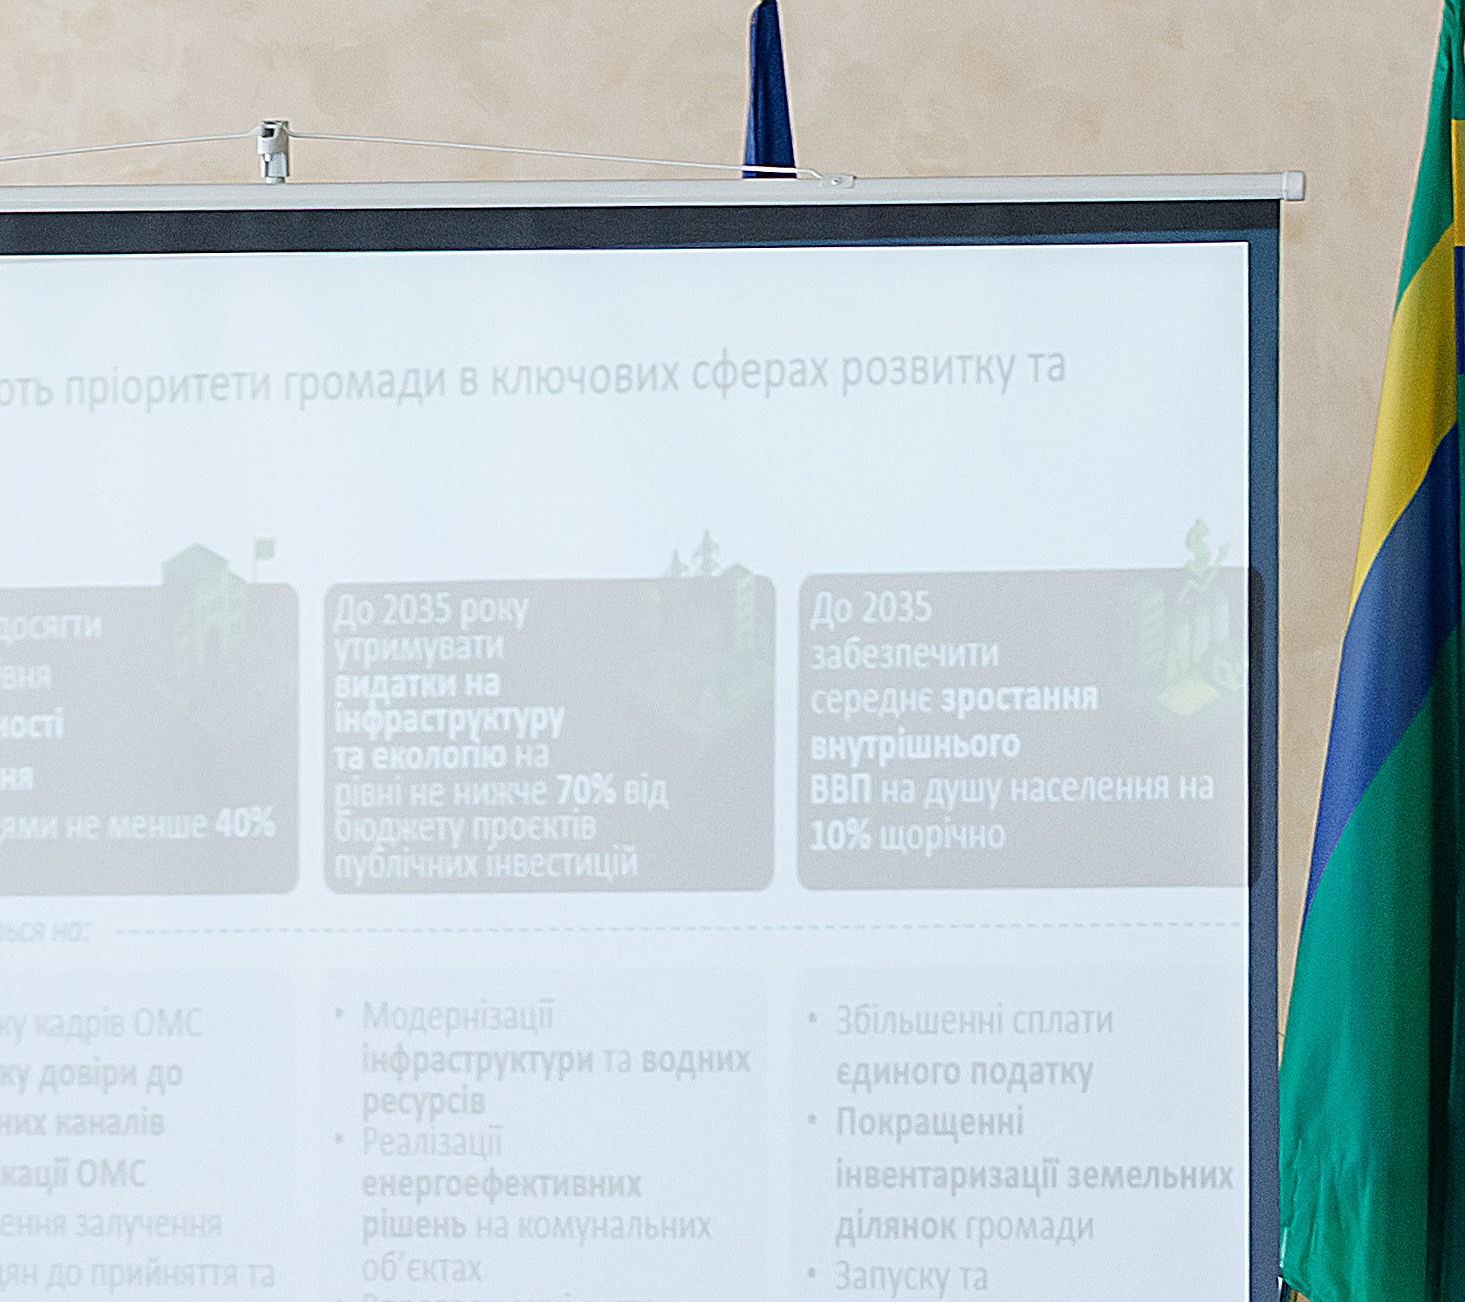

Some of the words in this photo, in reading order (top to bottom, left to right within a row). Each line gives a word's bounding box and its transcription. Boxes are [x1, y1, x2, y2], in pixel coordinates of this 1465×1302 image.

[66, 366, 270, 414] пріоритети
[285, 368, 445, 410] громади
[460, 367, 478, 395] в
[492, 361, 680, 395] ключових
[692, 346, 829, 399] сферах
[843, 353, 1016, 398] розвитку
[1029, 352, 1067, 382] та
[333, 594, 372, 632] До
[383, 593, 452, 624] 2035
[461, 598, 529, 630] року
[810, 592, 851, 630] До
[862, 591, 932, 623] 2035
[334, 635, 504, 670] утримувати
[812, 636, 999, 669] забезпечити
[335, 673, 456, 705] видатки
[465, 672, 501, 696] на
[812, 688, 933, 721] середнє
[941, 686, 1099, 719] зростання
[334, 702, 566, 740] інфраструктуру
[334, 747, 363, 770] та
[515, 744, 549, 768] на
[811, 727, 1020, 767] внутрішнього
[335, 774, 402, 812] рівні
[410, 781, 444, 806] не
[453, 779, 548, 805] нижче
[557, 773, 615, 804] 70%
[625, 772, 669, 809] від
[811, 774, 871, 804] ВВП
[881, 778, 915, 804] на
[923, 778, 1001, 810] душу
[1011, 774, 1169, 802] населення
[1180, 774, 1214, 800] на
[335, 809, 465, 849] бюджету
[811, 818, 871, 850] 10%
[880, 817, 1005, 857] щорічно
[334, 847, 478, 886] публічних
[486, 844, 638, 882] інвестицій
[35, 1006, 124, 1044] кадрів
[134, 1008, 203, 1038] ОМС
[362, 998, 555, 1037] Модернізації
[836, 1003, 1003, 1035] Збільшенні
[1012, 1010, 1114, 1035] сплати
[39, 1056, 137, 1094] довіри
[146, 1064, 183, 1094] до
[362, 1043, 593, 1081] інфраструктури
[603, 1049, 632, 1073] та
[642, 1049, 751, 1080] водних
[836, 1062, 960, 1093] єдиного
[971, 1061, 1094, 1093] податку
[55, 1106, 165, 1136] каналів
[362, 1085, 486, 1122] ресурсів
[362, 1124, 503, 1161] Реалізації
[836, 1105, 1024, 1144] Покращенні
[77, 1159, 146, 1187] ОМС
[362, 1167, 642, 1204] енергоефективних
[836, 1158, 1060, 1197] інвентаризації
[1067, 1164, 1234, 1190] земельних
[76, 1214, 222, 1245] залучення
[362, 1207, 467, 1246] рішень
[476, 1216, 508, 1239] на
[518, 1216, 712, 1247] комунальних
[835, 1209, 956, 1248] ділянок
[966, 1216, 1094, 1248] громади
[835, 1261, 950, 1297] Запуску
[960, 1267, 988, 1291] та
